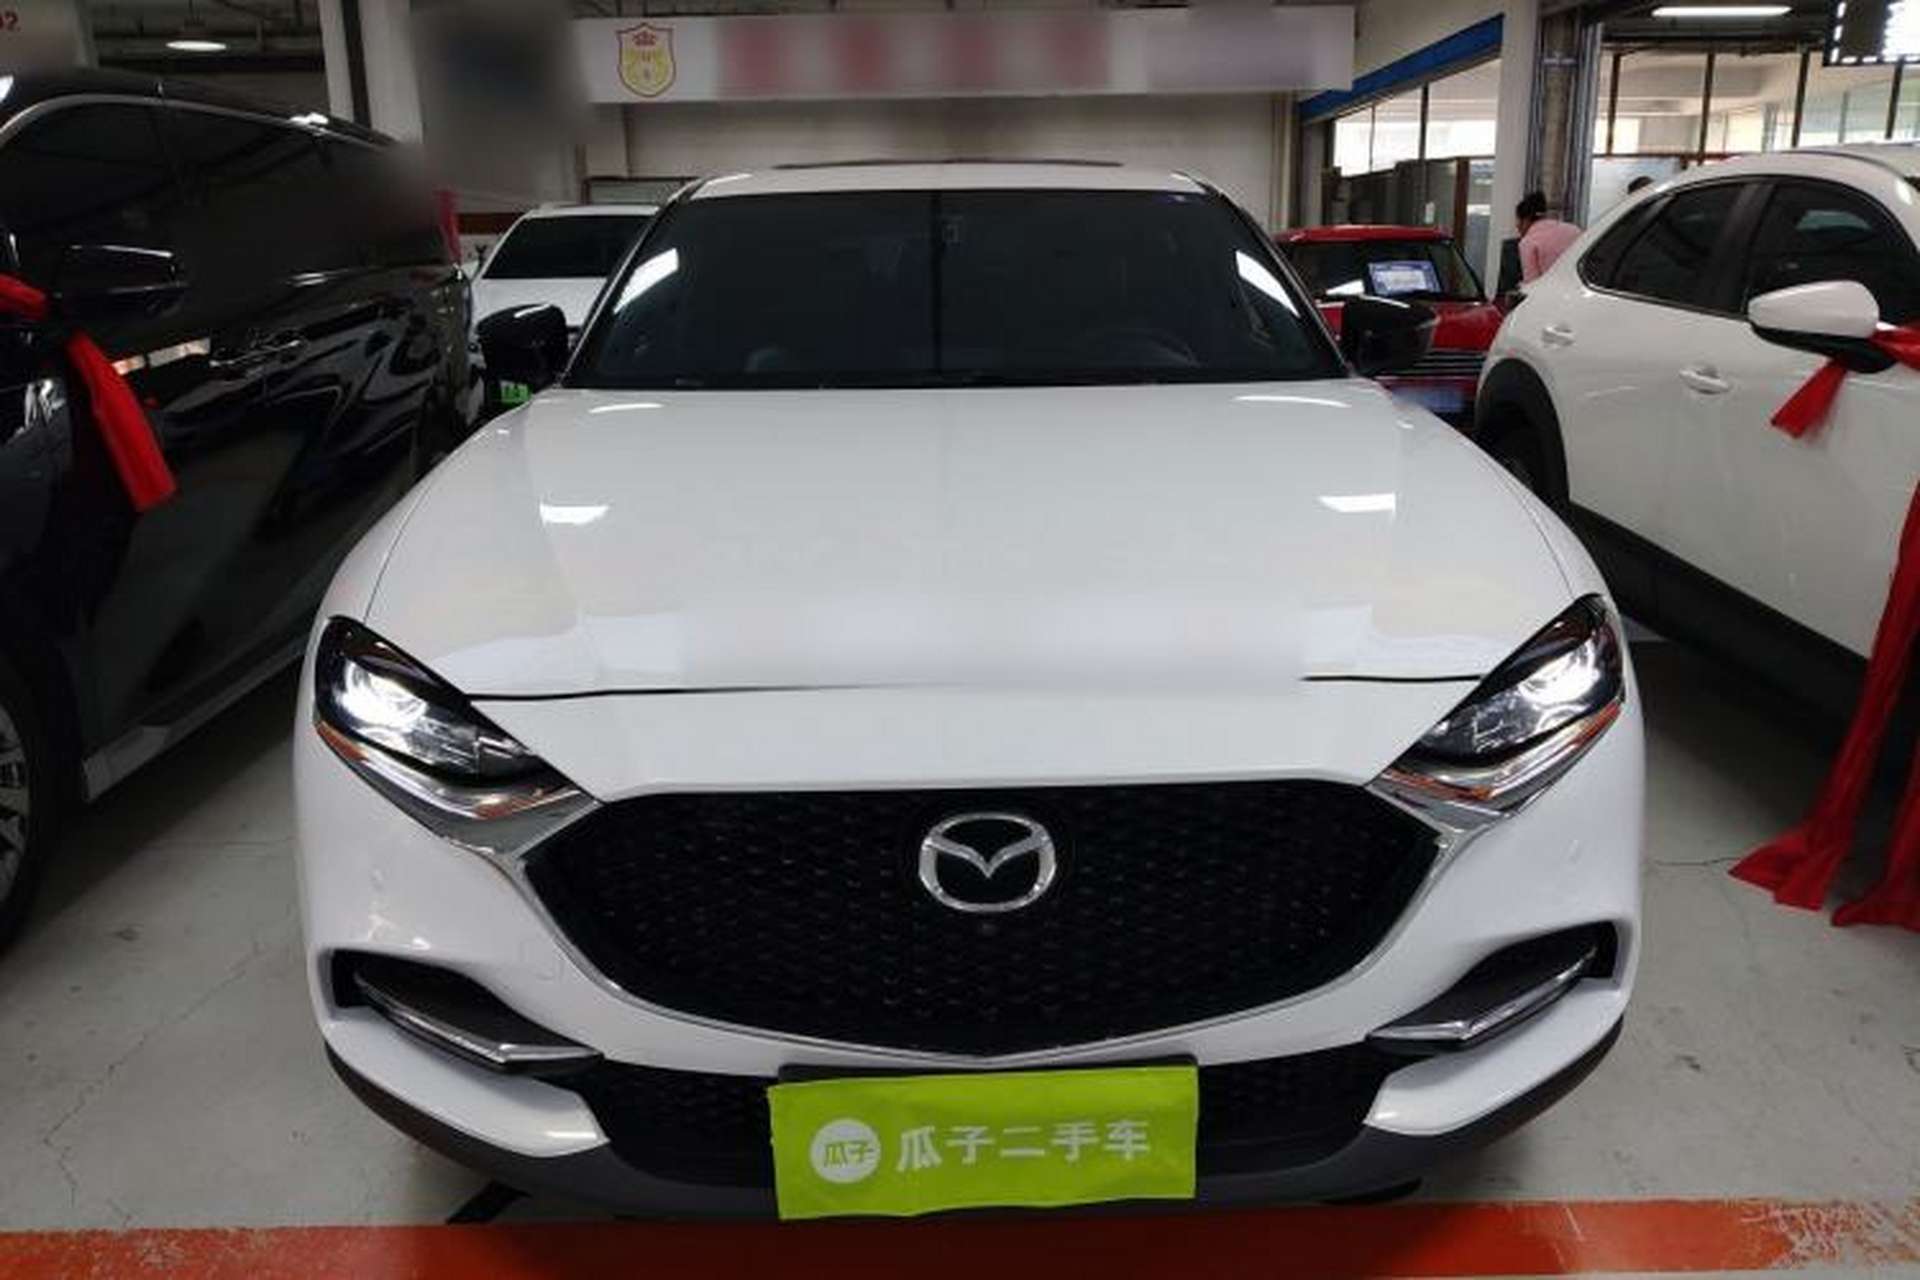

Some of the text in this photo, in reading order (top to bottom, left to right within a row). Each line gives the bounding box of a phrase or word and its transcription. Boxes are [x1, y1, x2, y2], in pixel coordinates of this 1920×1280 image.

[823, 1140, 875, 1168] 瓜子
[897, 1119, 1150, 1172] 瓜子二手车
